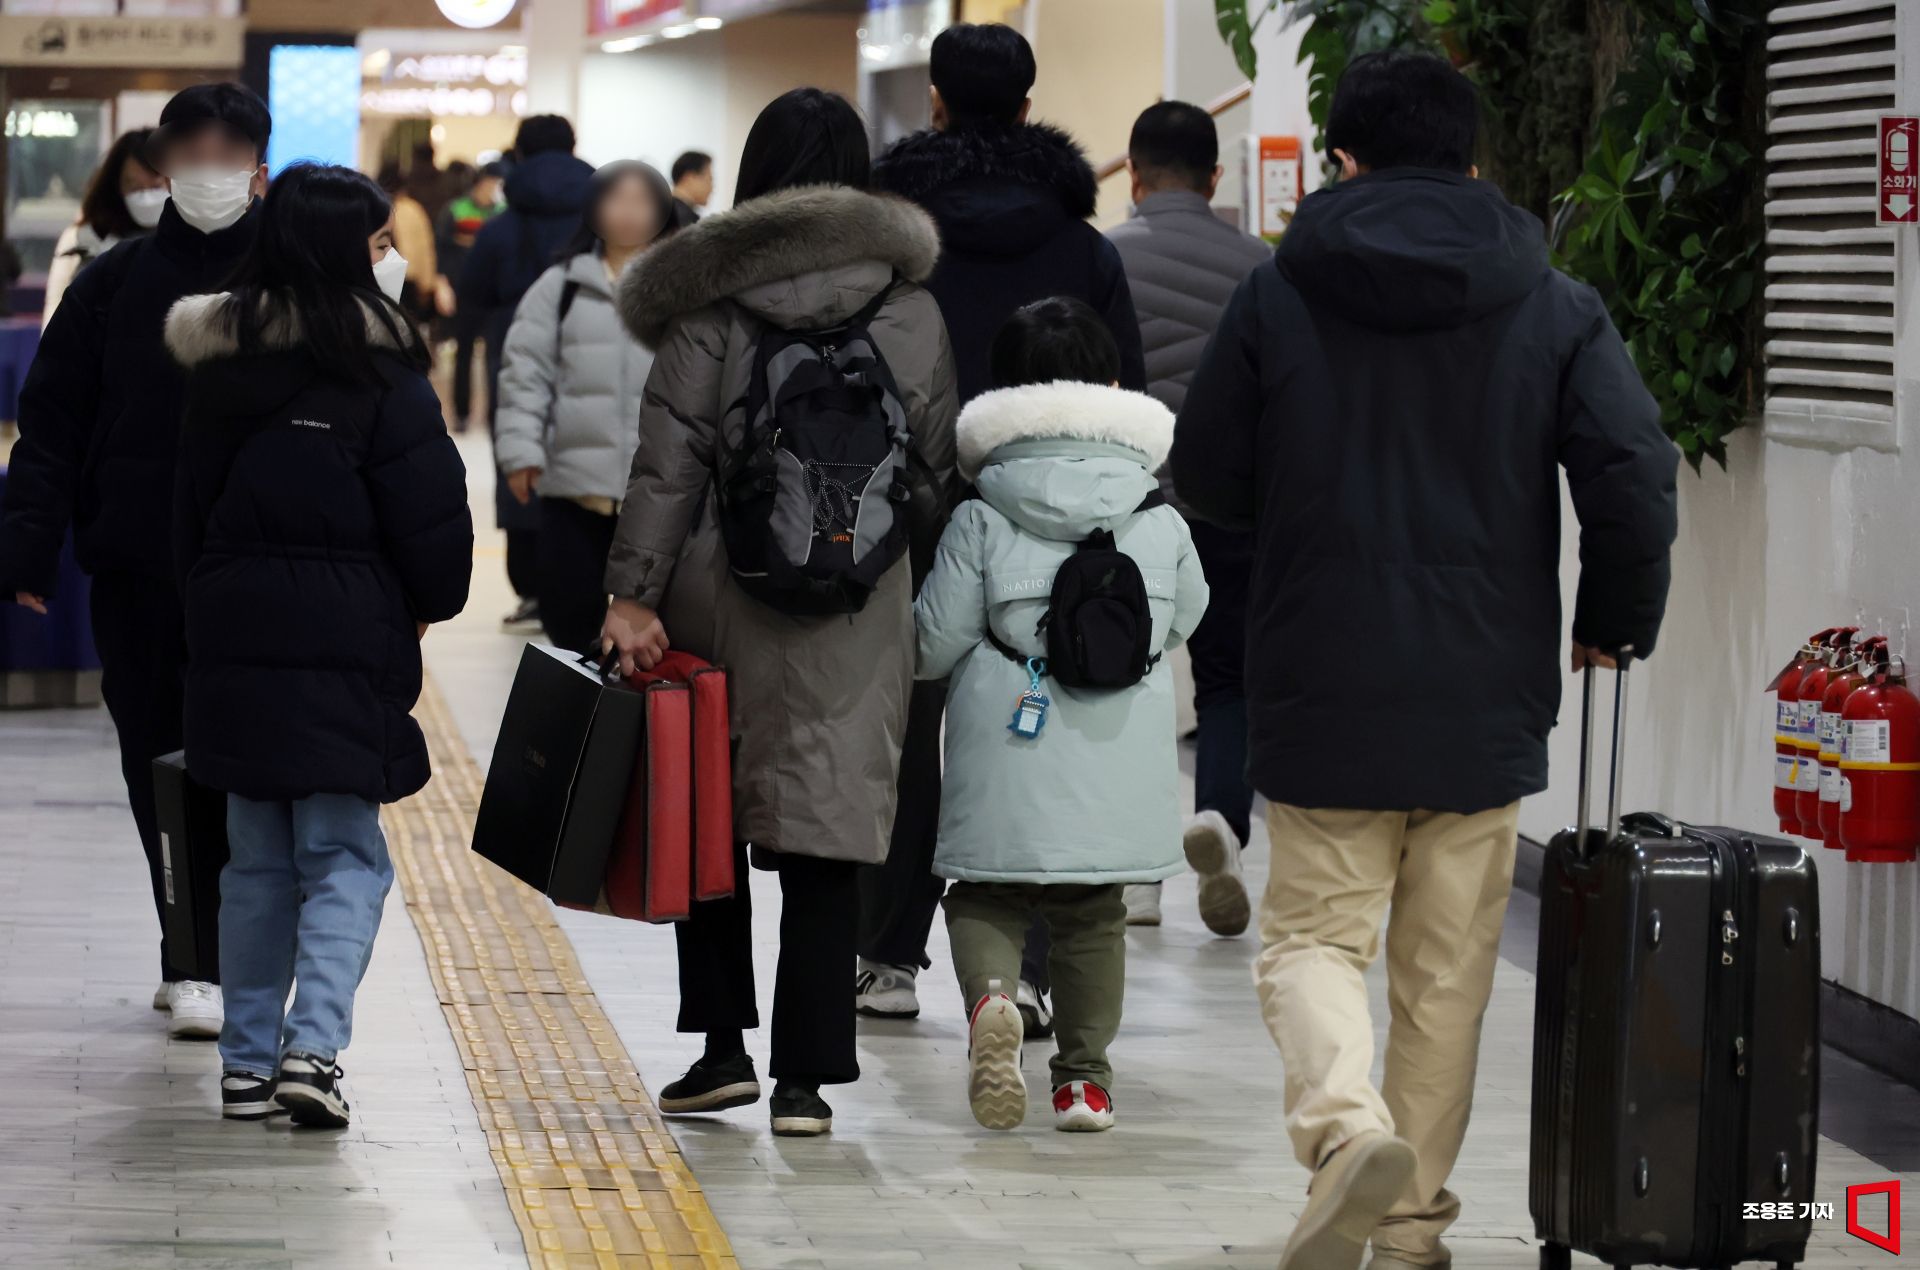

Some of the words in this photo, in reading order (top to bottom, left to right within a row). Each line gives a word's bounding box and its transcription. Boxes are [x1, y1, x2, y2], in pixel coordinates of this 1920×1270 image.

[1883, 175, 1917, 188] 소화기
[303, 419, 331, 429] balance
[1002, 578, 1050, 593] NATIO
